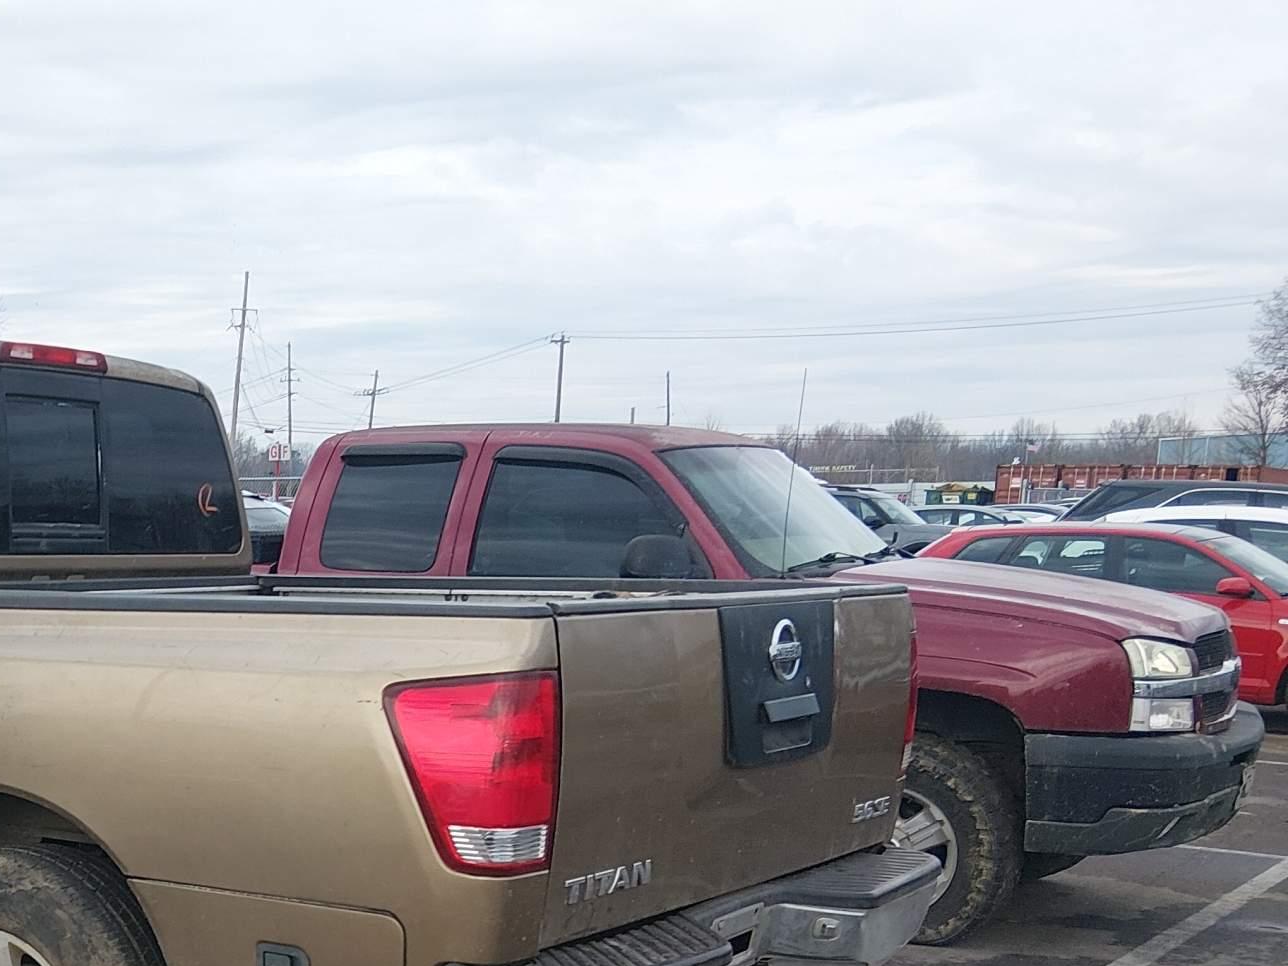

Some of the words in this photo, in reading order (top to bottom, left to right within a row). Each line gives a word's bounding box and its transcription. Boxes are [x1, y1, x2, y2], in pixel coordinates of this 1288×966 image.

[270, 445, 278, 458] G
[282, 445, 289, 458] F
[564, 859, 652, 905] TITAN
